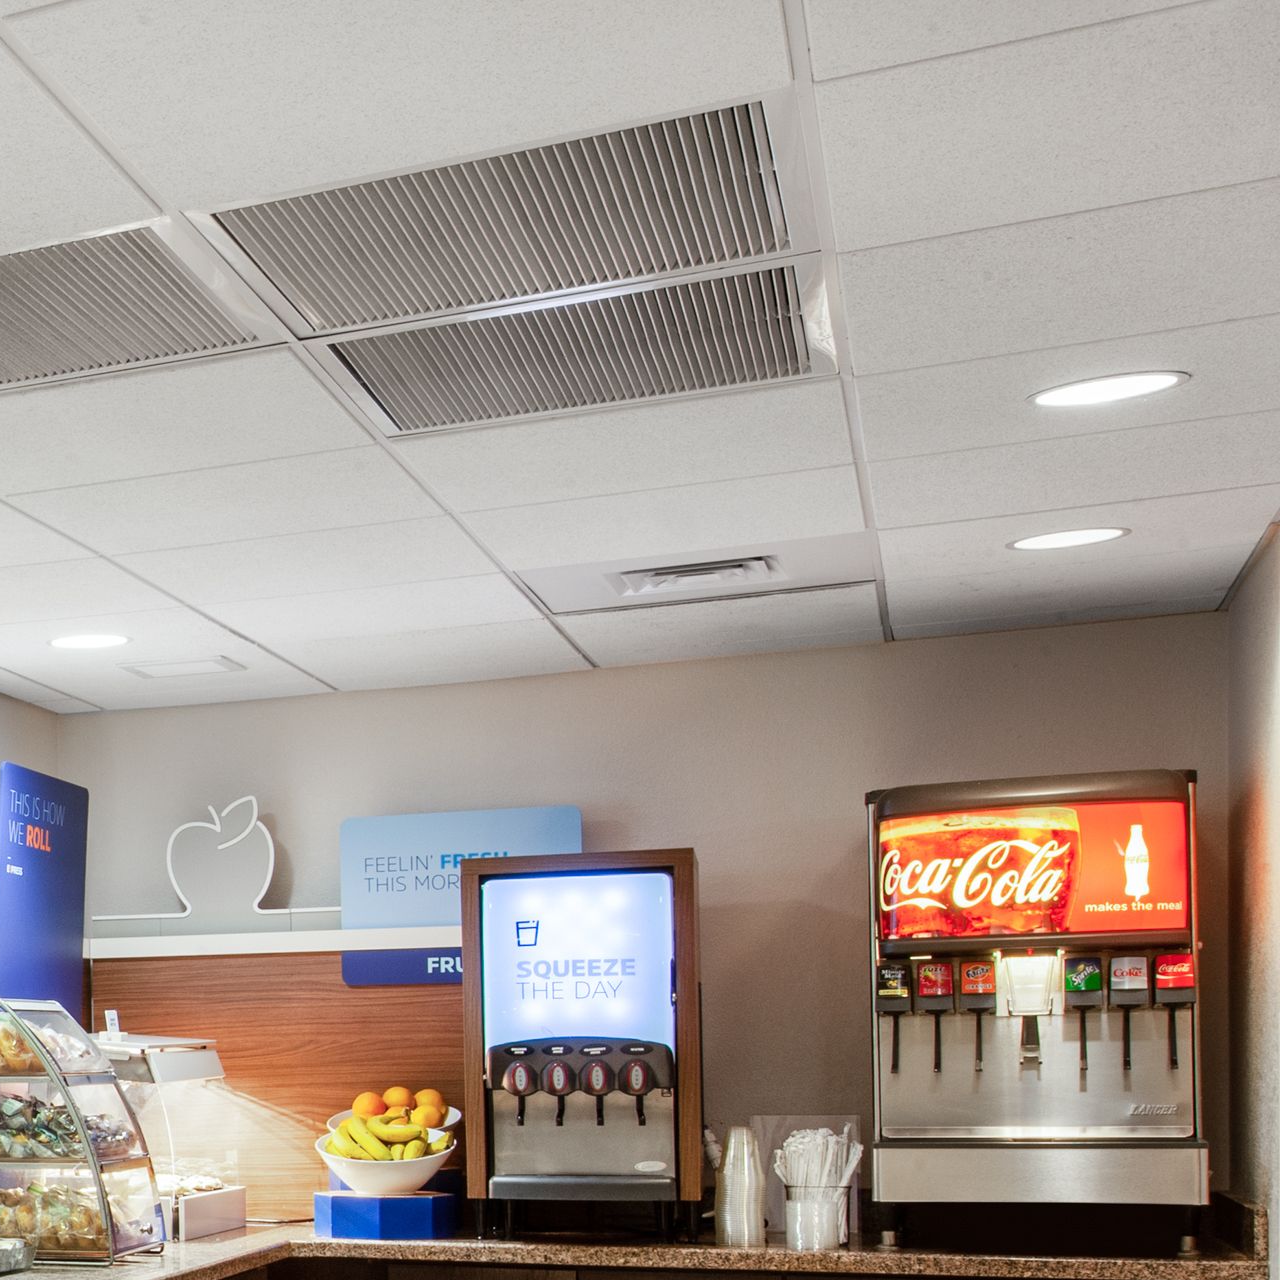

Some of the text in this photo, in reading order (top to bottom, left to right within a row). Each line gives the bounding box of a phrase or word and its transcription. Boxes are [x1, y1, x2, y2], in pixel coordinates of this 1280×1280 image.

[10, 789, 66, 827] THIS IS HOW
[8, 819, 51, 852] WE ROLL
[364, 876, 407, 892] THIS
[880, 838, 1071, 911] Coca-Cola
[1084, 901, 1183, 913] makes the meal
[516, 958, 636, 979] SQUEEZE
[516, 980, 623, 1001] THE DAY
